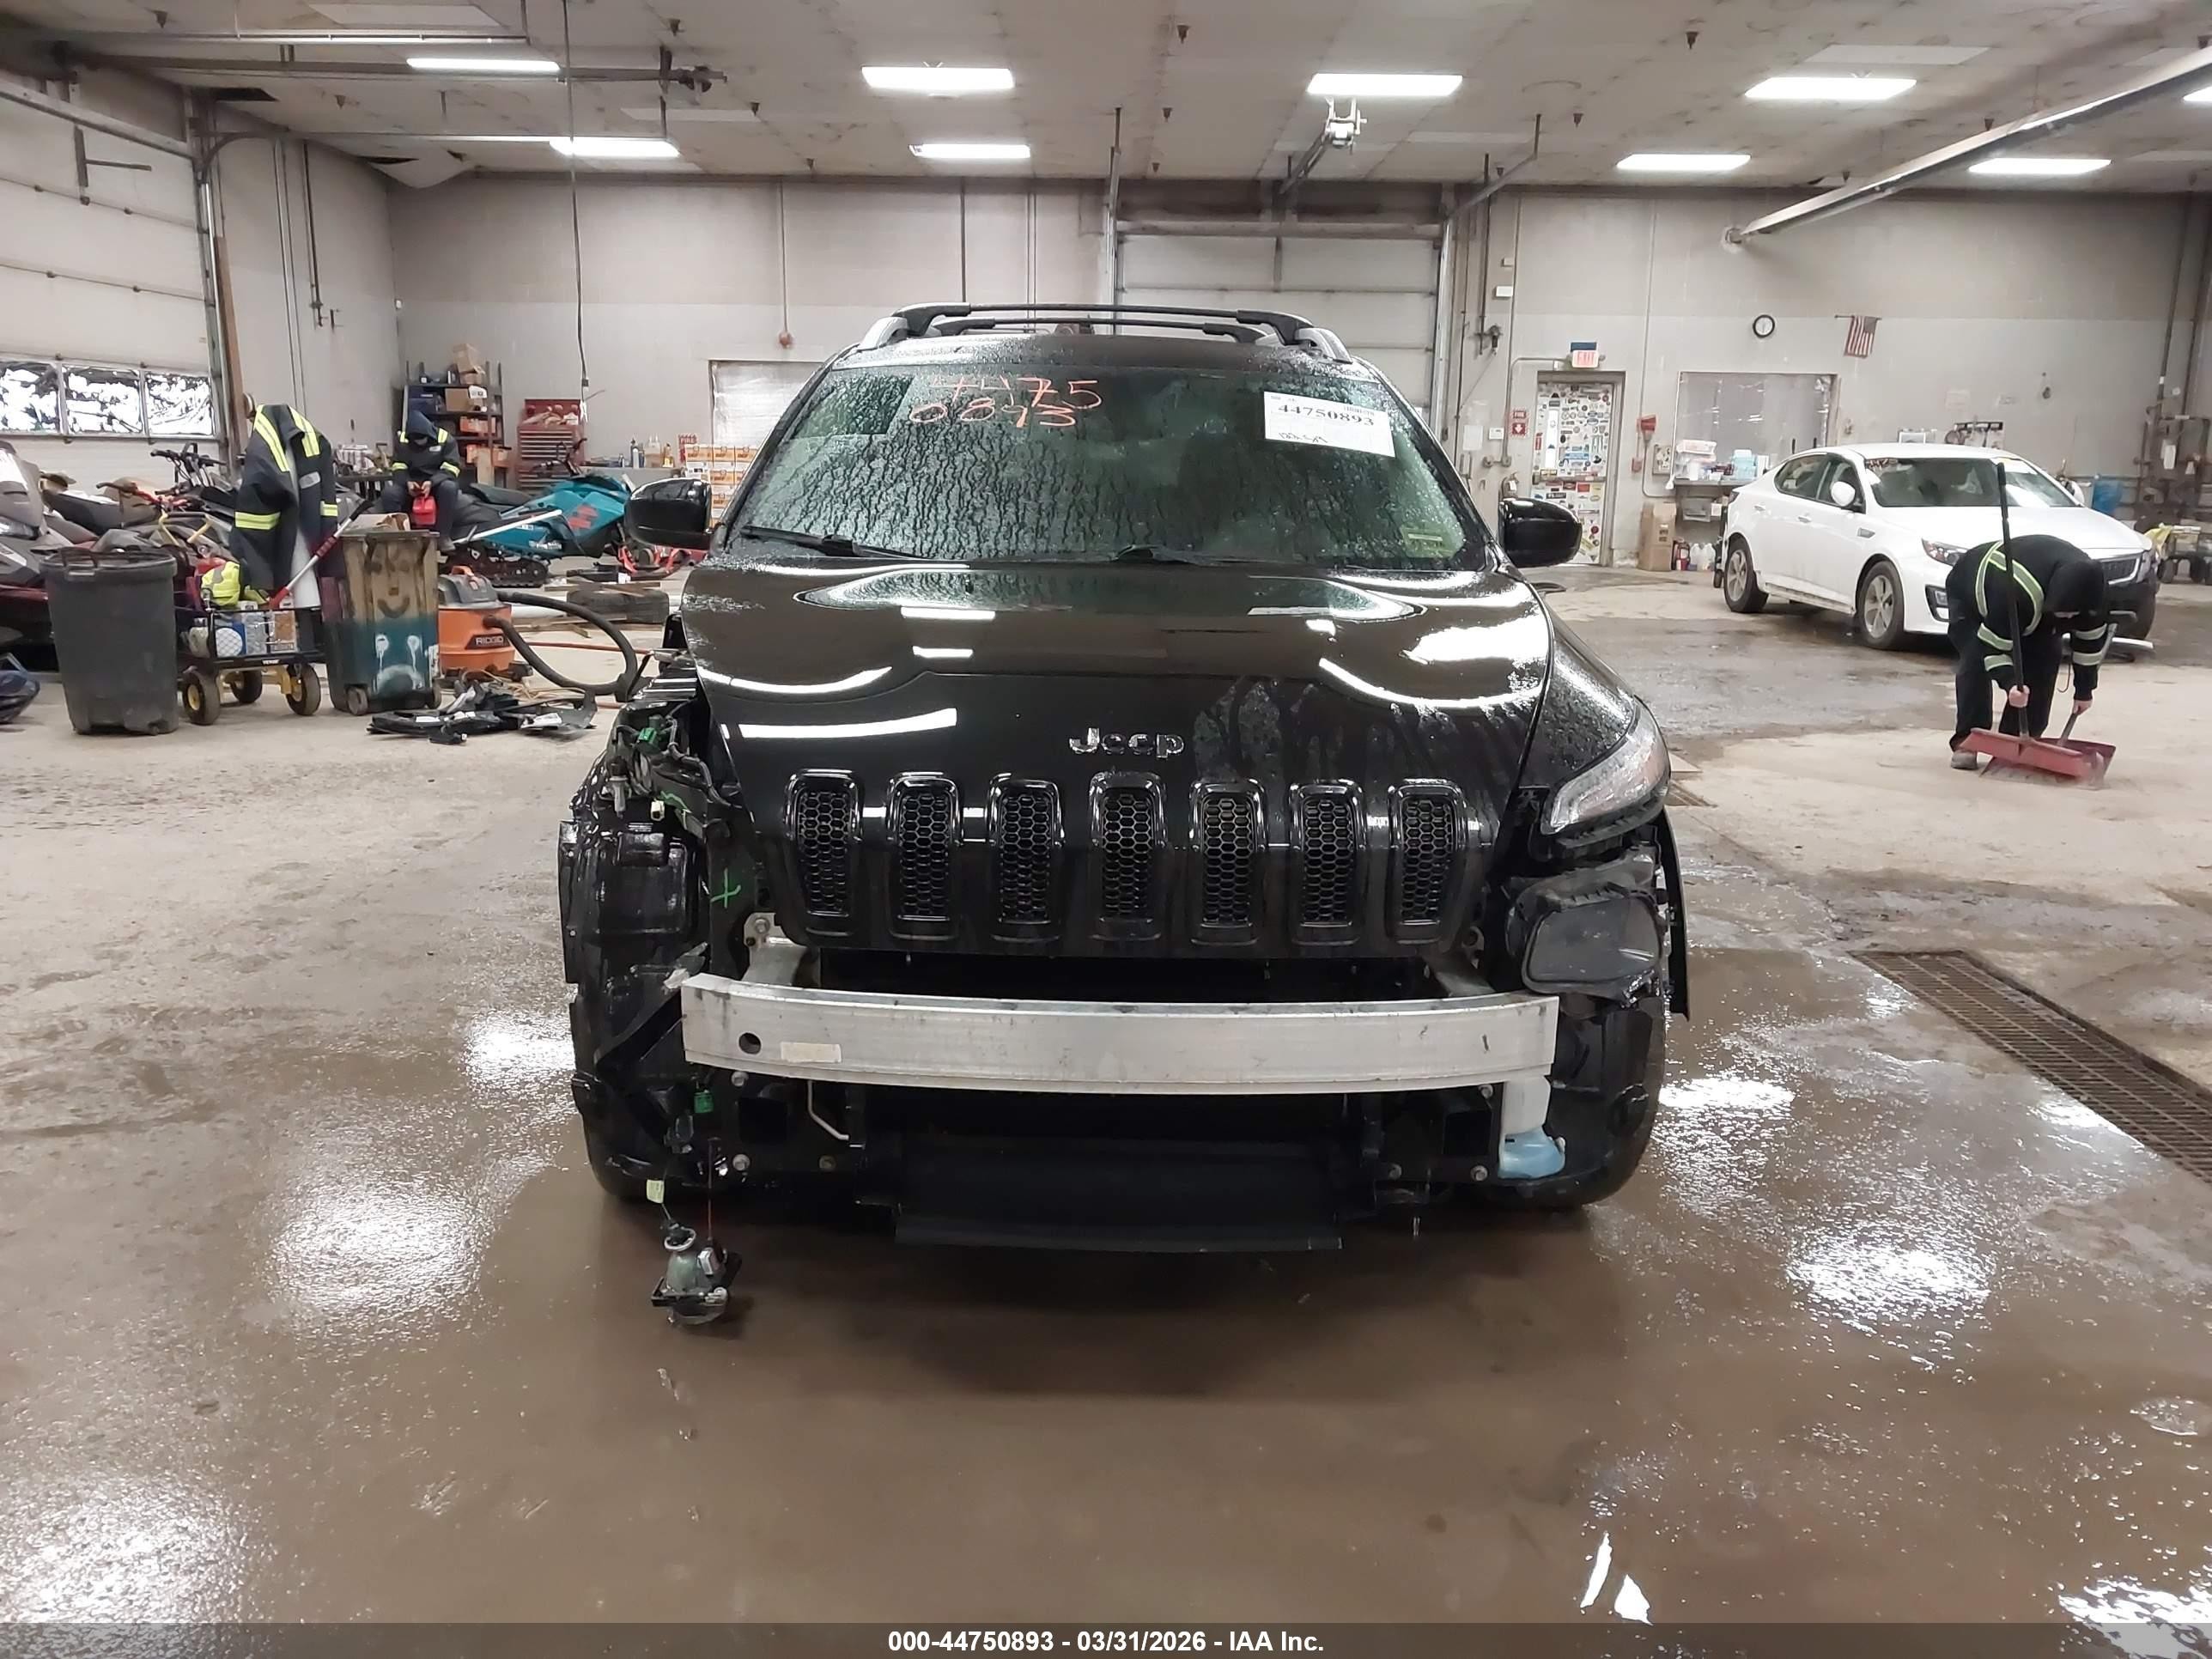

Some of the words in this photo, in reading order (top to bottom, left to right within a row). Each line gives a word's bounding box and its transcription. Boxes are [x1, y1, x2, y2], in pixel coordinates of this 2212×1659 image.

[1577, 351, 1595, 366] EXIT
[908, 397, 1077, 428] 0893
[1278, 404, 1375, 426] 44750893
[1069, 727, 1185, 759] Jeep
